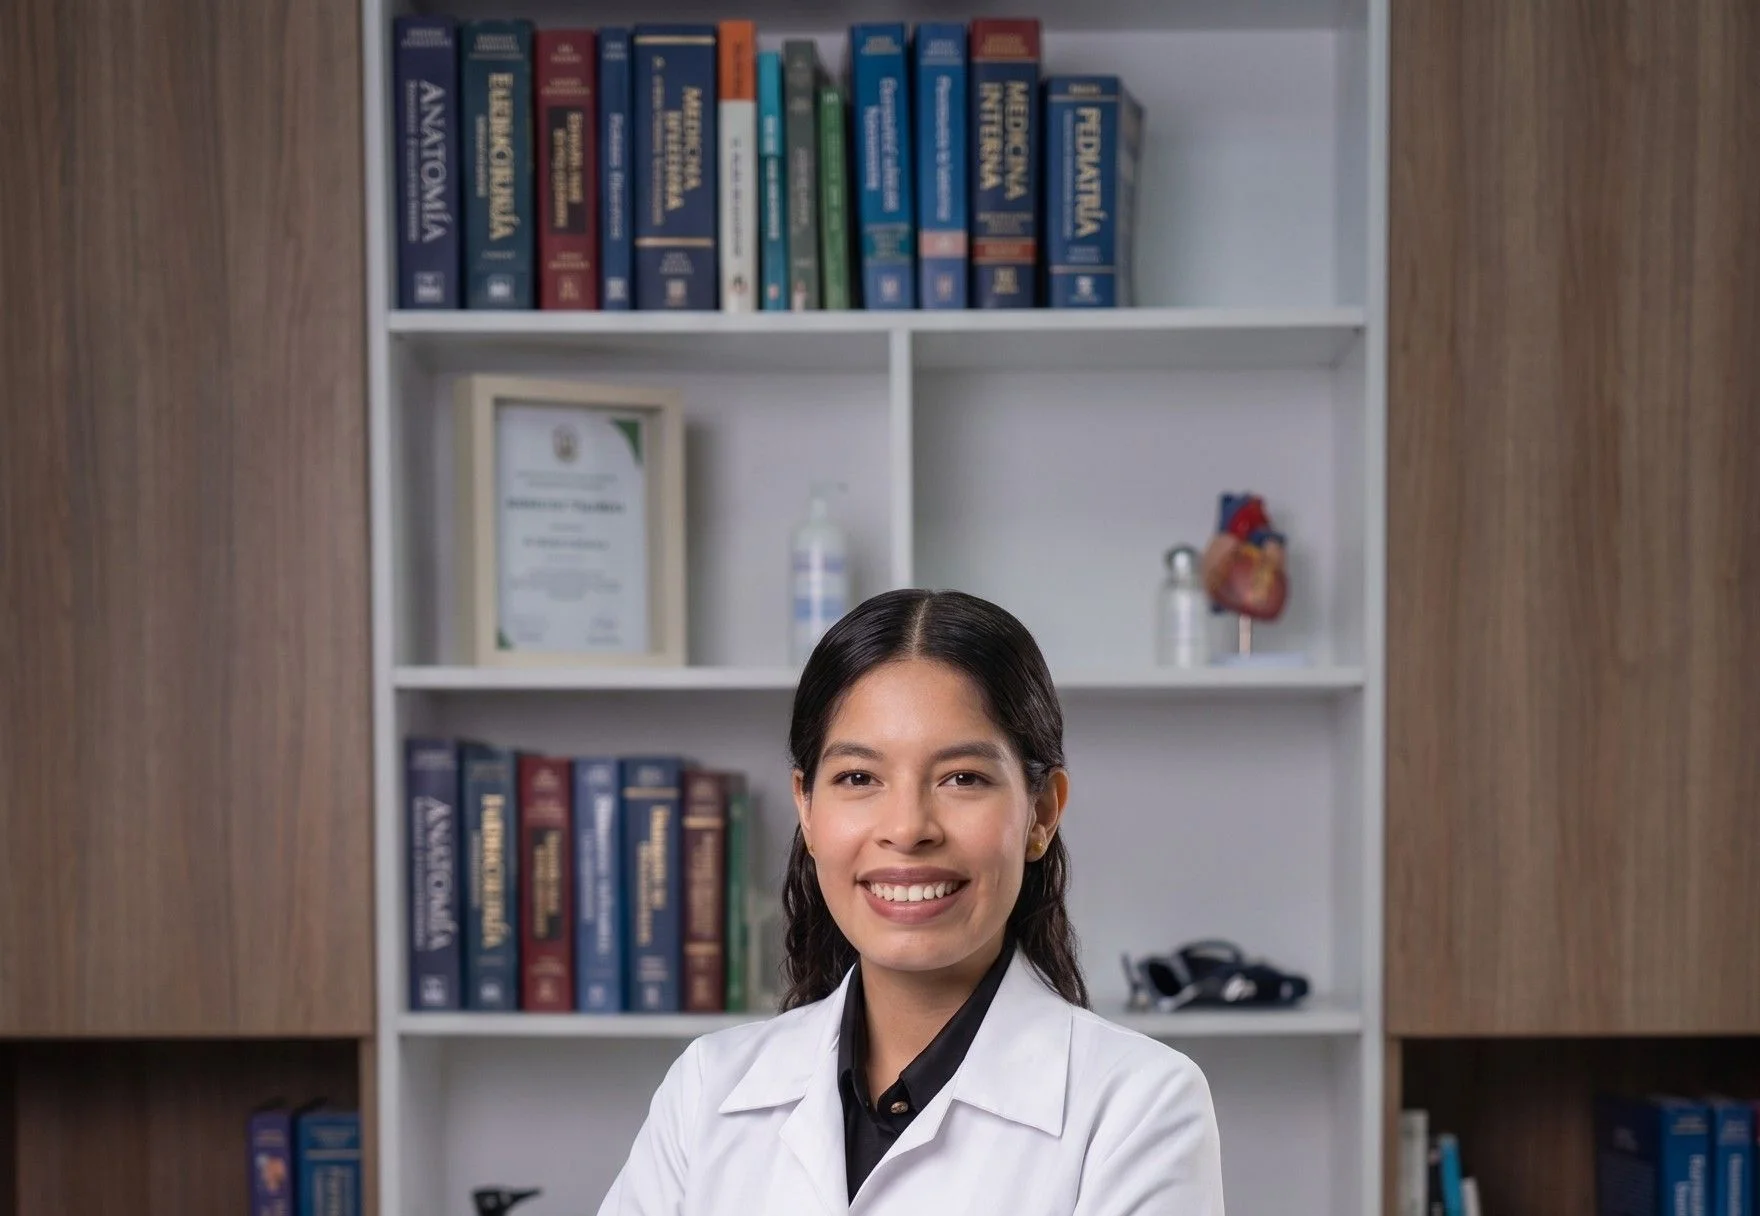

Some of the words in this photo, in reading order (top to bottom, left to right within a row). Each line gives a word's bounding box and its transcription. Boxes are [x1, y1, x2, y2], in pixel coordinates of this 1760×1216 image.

[420, 79, 453, 243] ANATOMÍA
[979, 82, 1003, 191] INTERNA
[1004, 81, 1029, 201] MEDICINA
[1075, 107, 1108, 239] PEDIATRÍA
